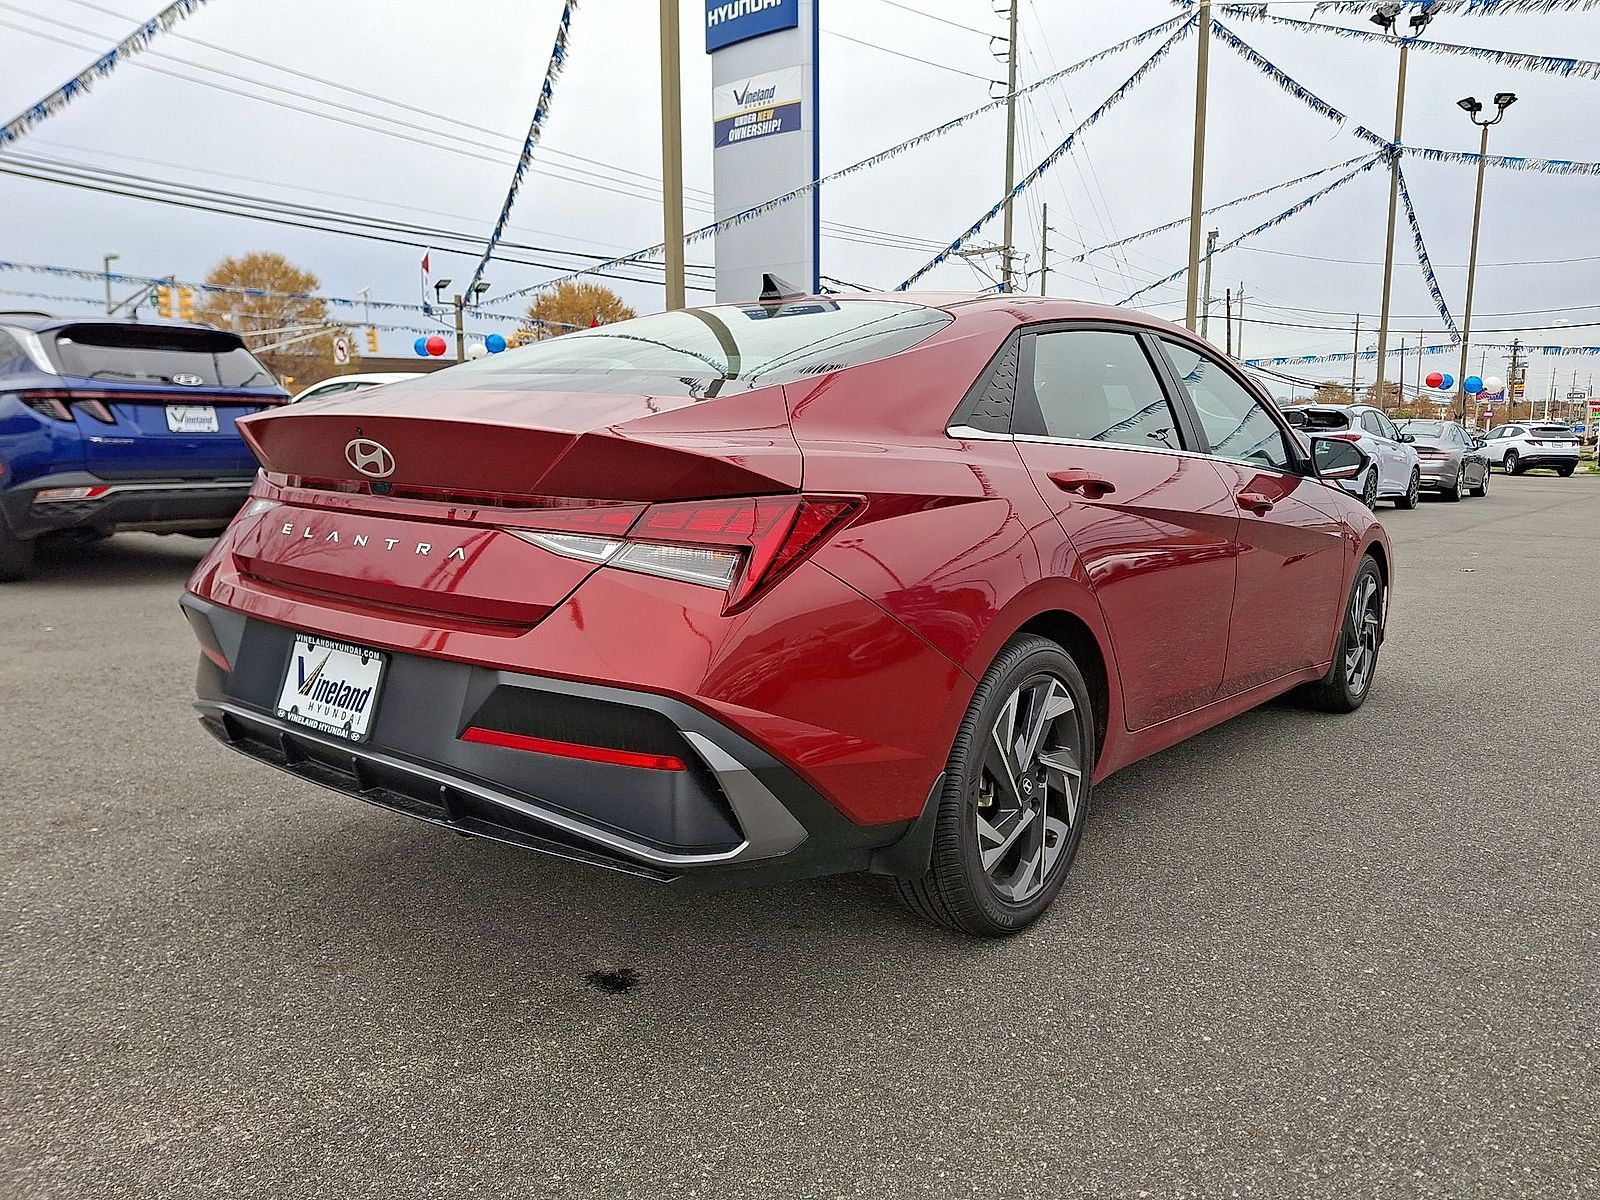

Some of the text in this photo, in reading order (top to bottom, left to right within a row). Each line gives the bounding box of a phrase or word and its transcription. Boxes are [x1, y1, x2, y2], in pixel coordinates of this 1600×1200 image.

[733, 80, 776, 105] Vineland
[728, 118, 782, 142] OWNERSHIP!
[734, 109, 775, 127] UNDER NEW
[171, 410, 213, 424] Vineland
[281, 523, 466, 560] ELANTRA
[296, 633, 380, 660] VINELANDHYUNDAI.COM
[298, 649, 372, 714] Vineland
[287, 712, 349, 738] VINELAND HYUNDAI
[308, 701, 361, 726] HYUNDAI
